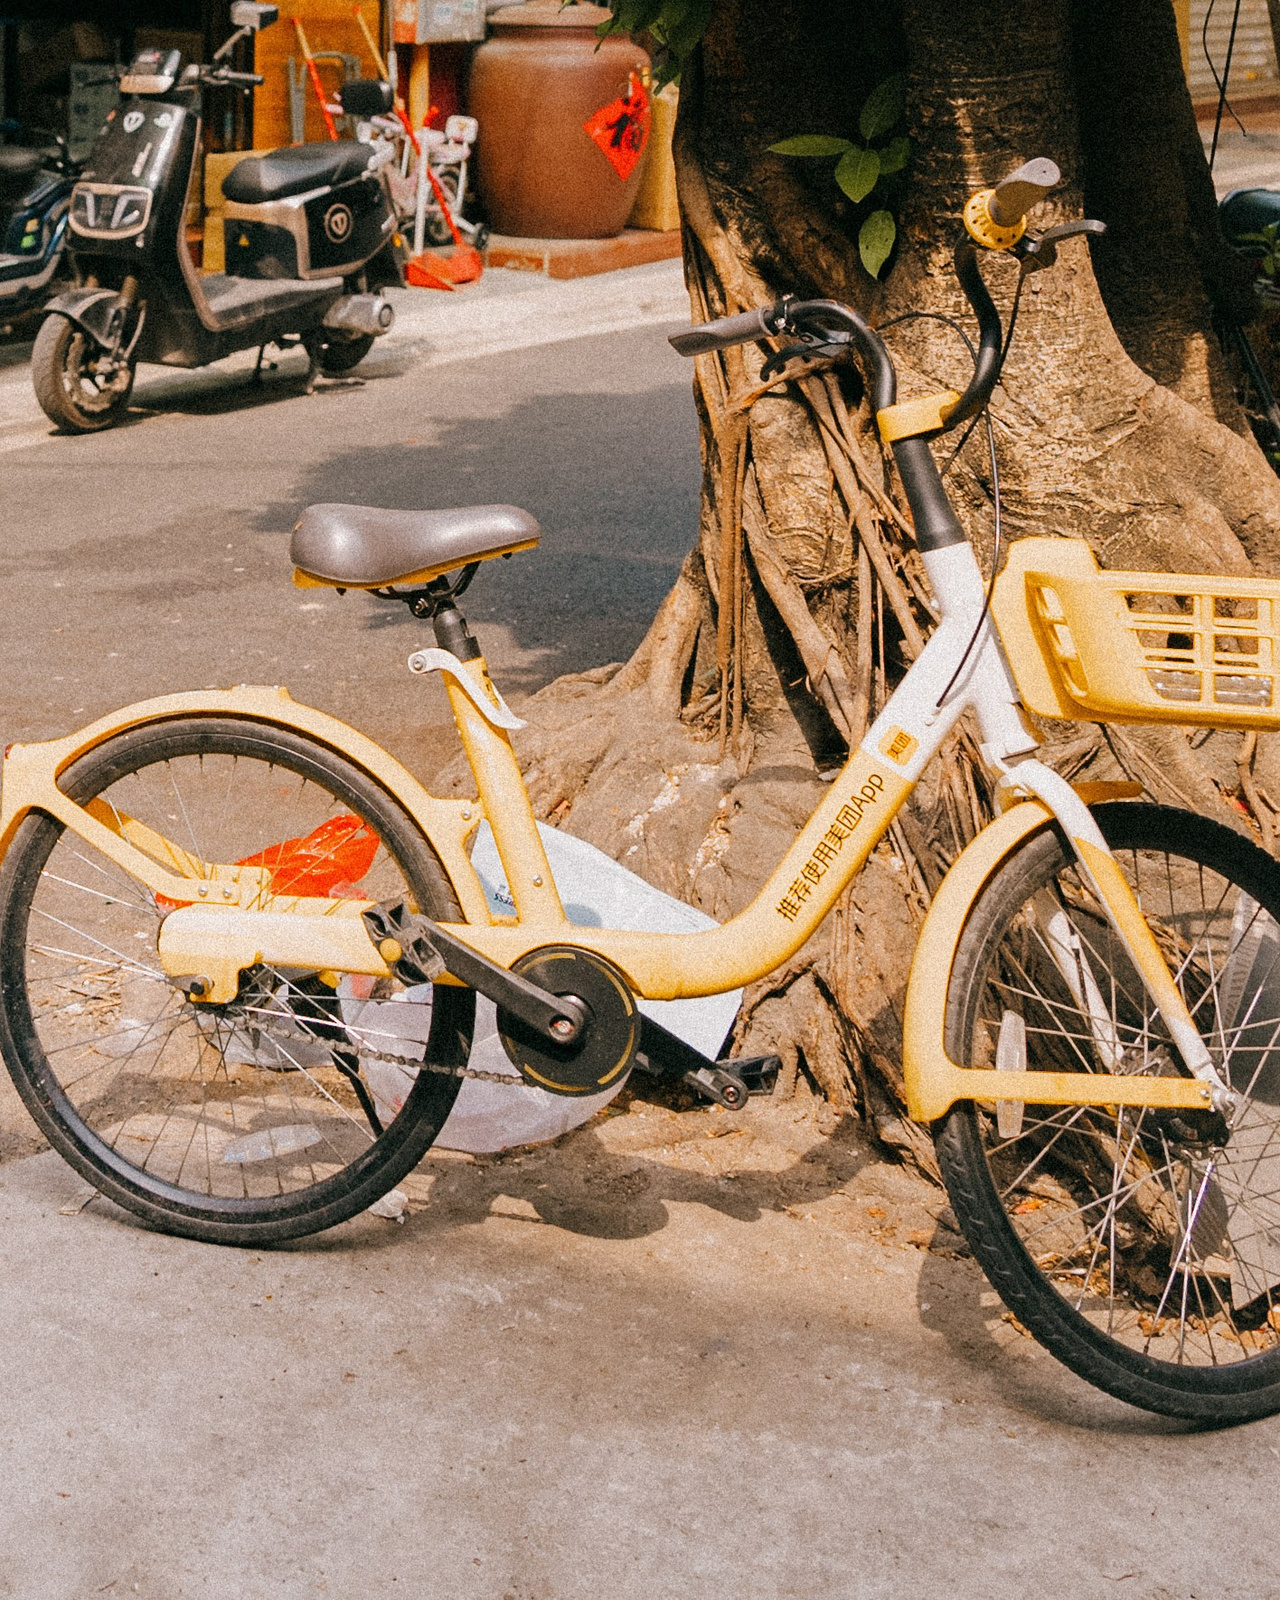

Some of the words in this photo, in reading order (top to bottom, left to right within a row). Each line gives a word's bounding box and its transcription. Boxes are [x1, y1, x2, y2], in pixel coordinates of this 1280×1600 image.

[887, 731, 912, 759] 美团
[775, 773, 885, 923] 推荐使用美团App
